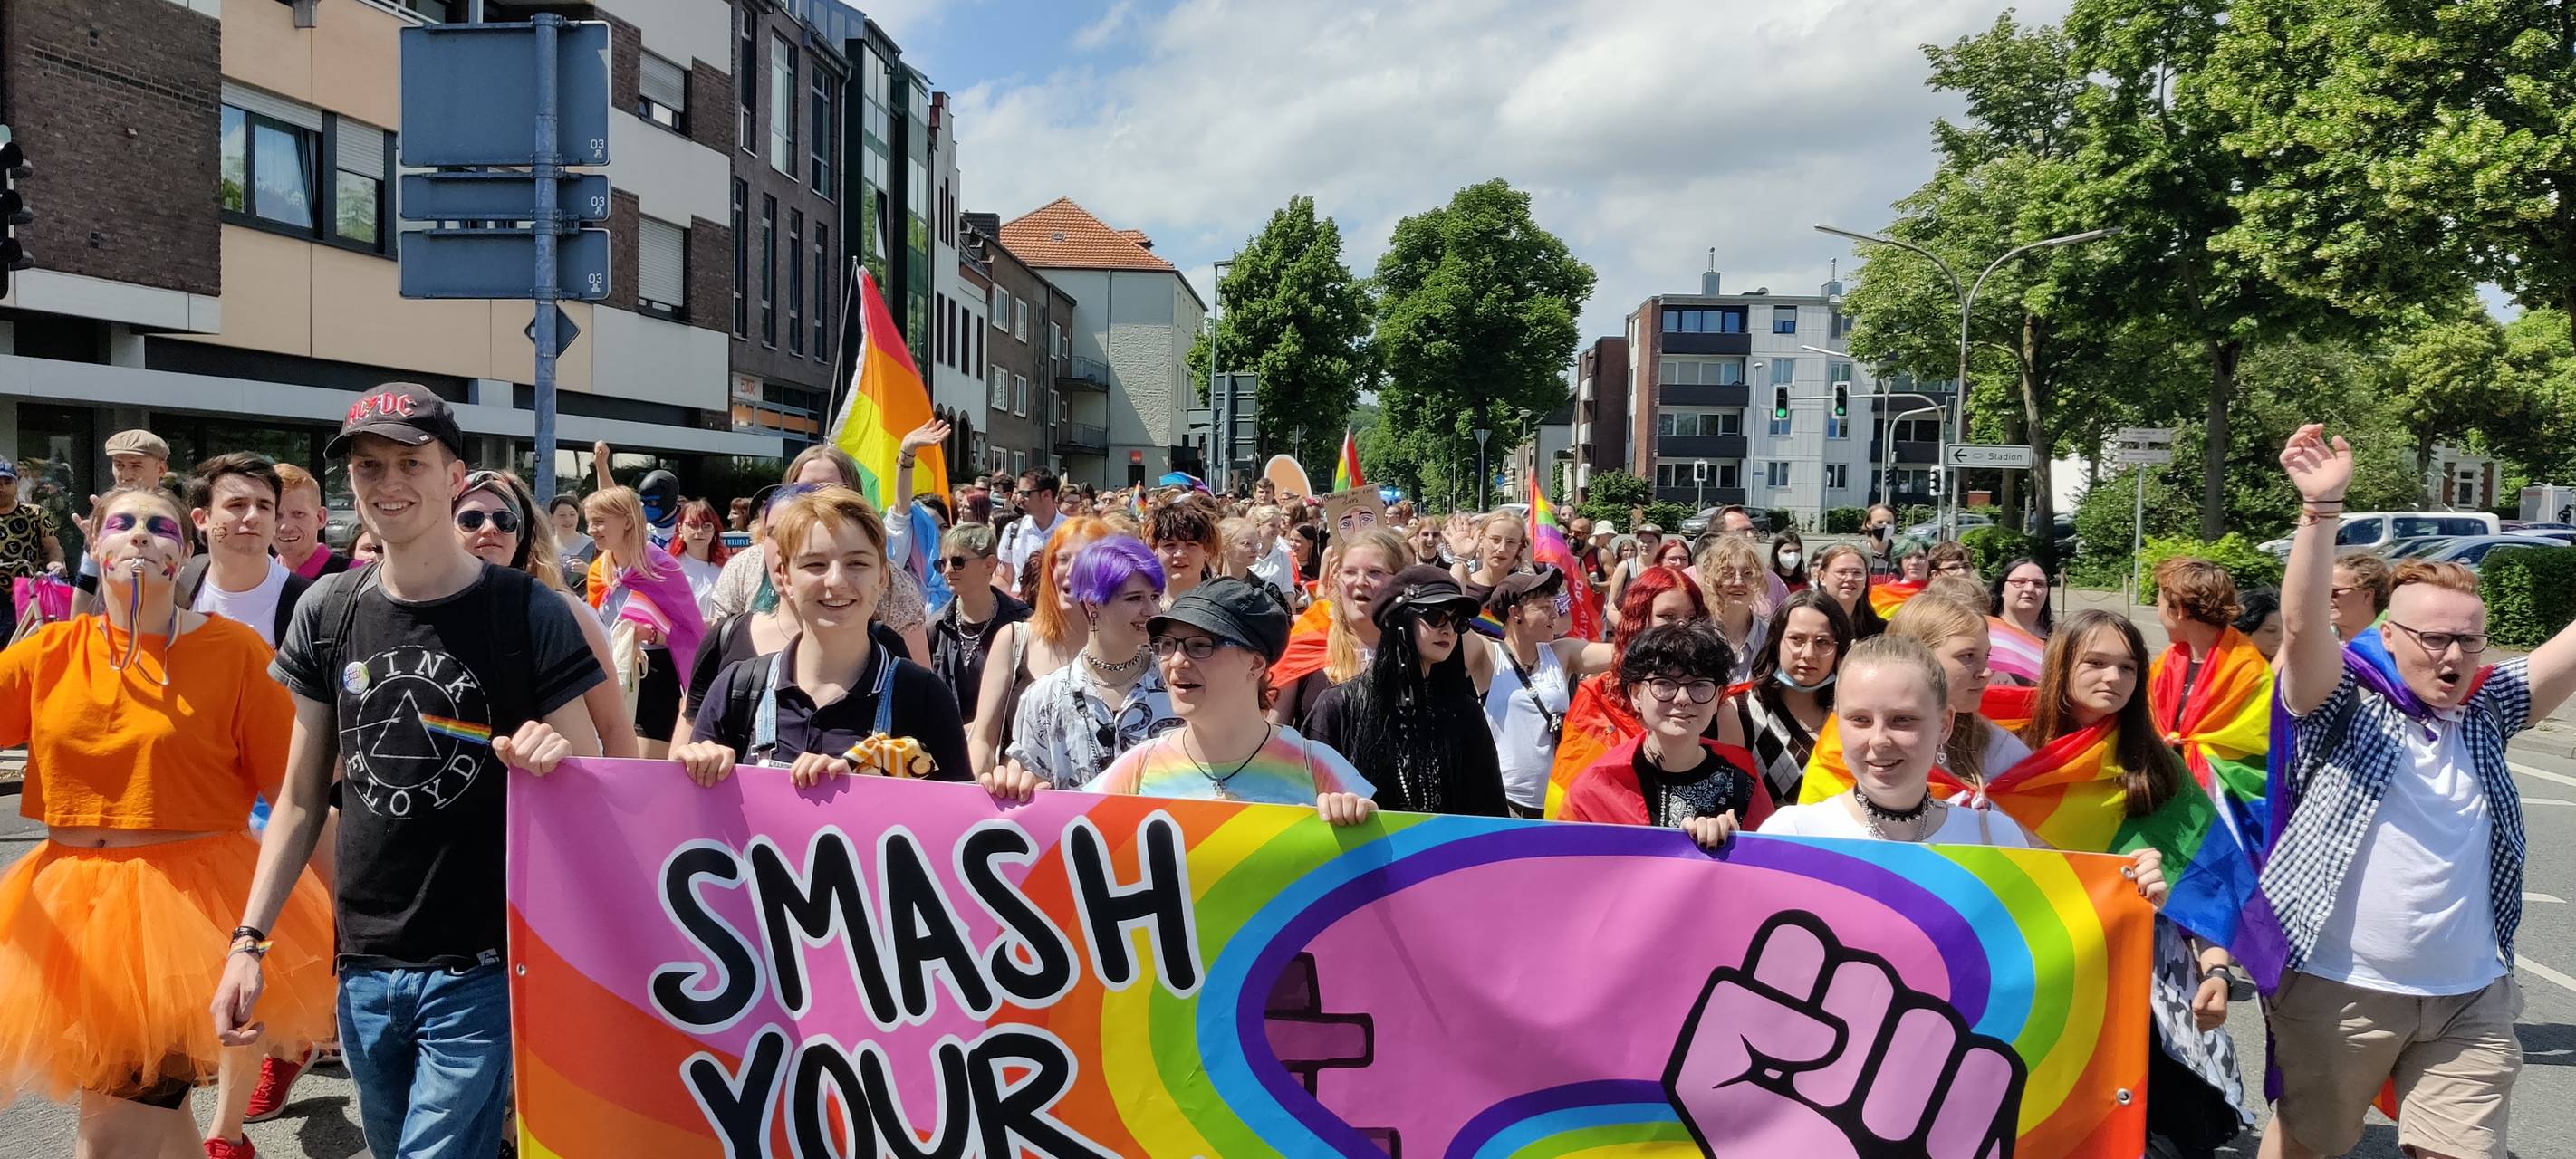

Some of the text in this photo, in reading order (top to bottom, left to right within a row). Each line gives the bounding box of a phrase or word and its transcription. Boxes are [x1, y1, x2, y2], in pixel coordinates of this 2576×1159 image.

[590, 139, 604, 150] 03
[591, 196, 605, 207] 03
[588, 273, 602, 283] 03
[1988, 452, 2023, 462] Stadion
[360, 650, 477, 704] INK
[346, 750, 476, 817] FLOYD
[650, 815, 1199, 1028] SMASH
[687, 1029, 1123, 1159] YOUR
